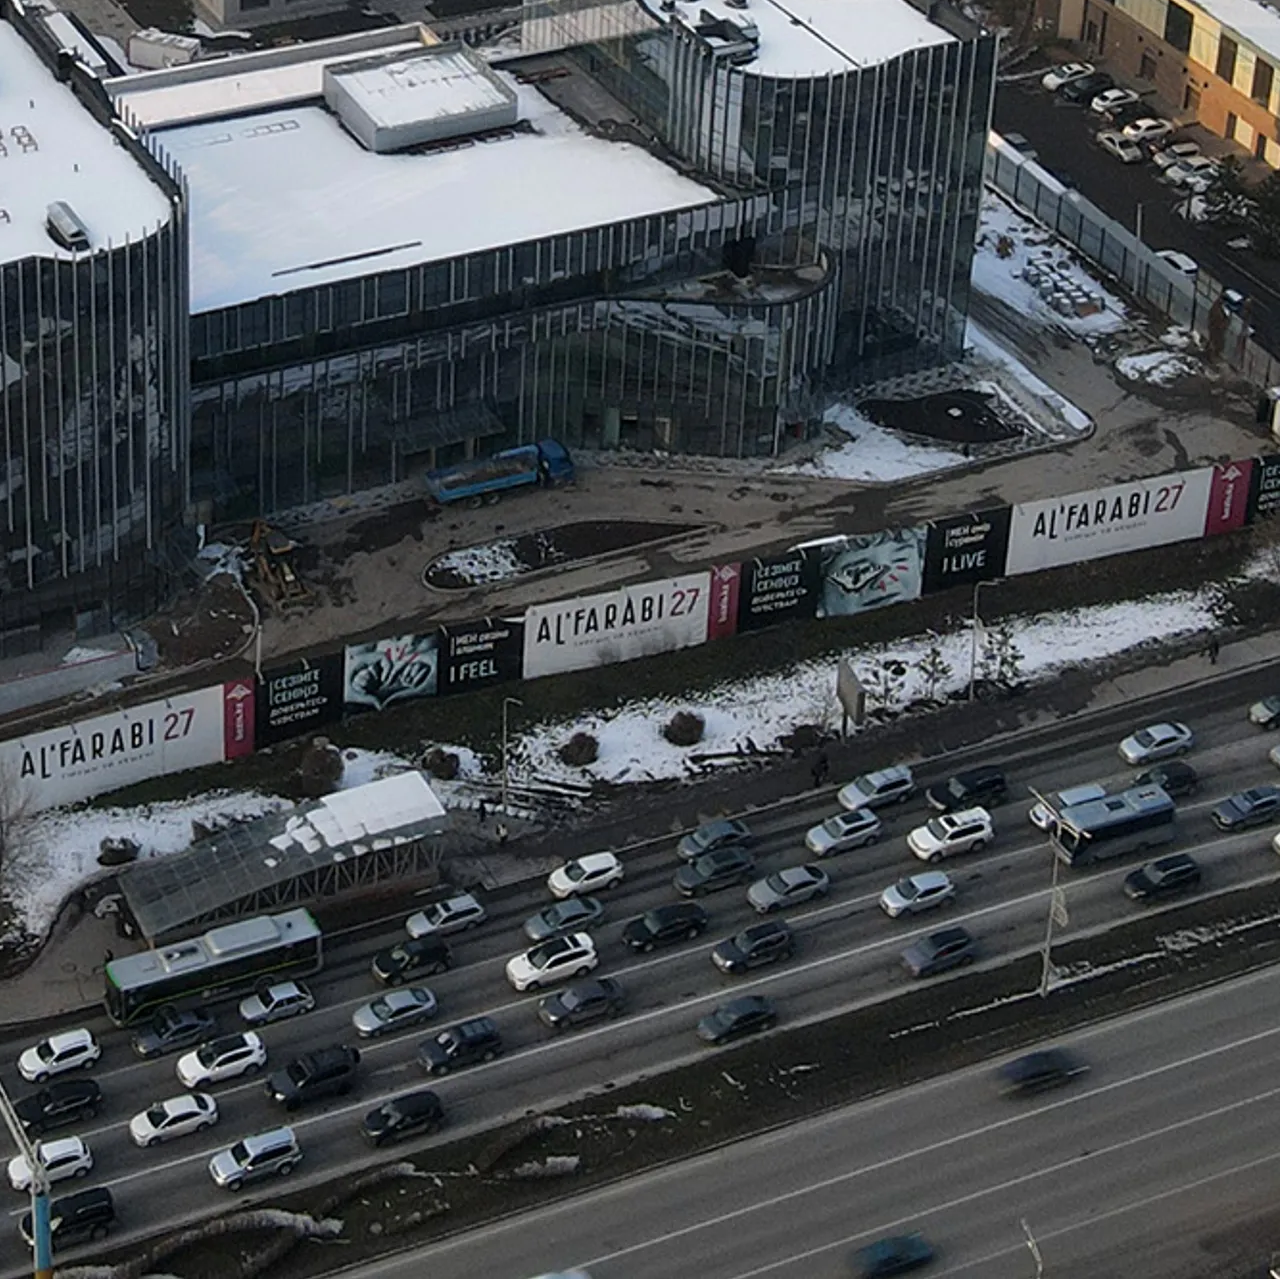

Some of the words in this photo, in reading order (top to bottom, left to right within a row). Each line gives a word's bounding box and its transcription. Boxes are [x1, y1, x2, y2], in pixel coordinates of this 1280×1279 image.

[1154, 484, 1185, 513] 27
[942, 557, 949, 574] I
[951, 549, 987, 572] LIVE
[670, 588, 701, 617] 27
[450, 665, 456, 683] I
[460, 659, 498, 681] FEEL
[163, 707, 195, 742] 27
